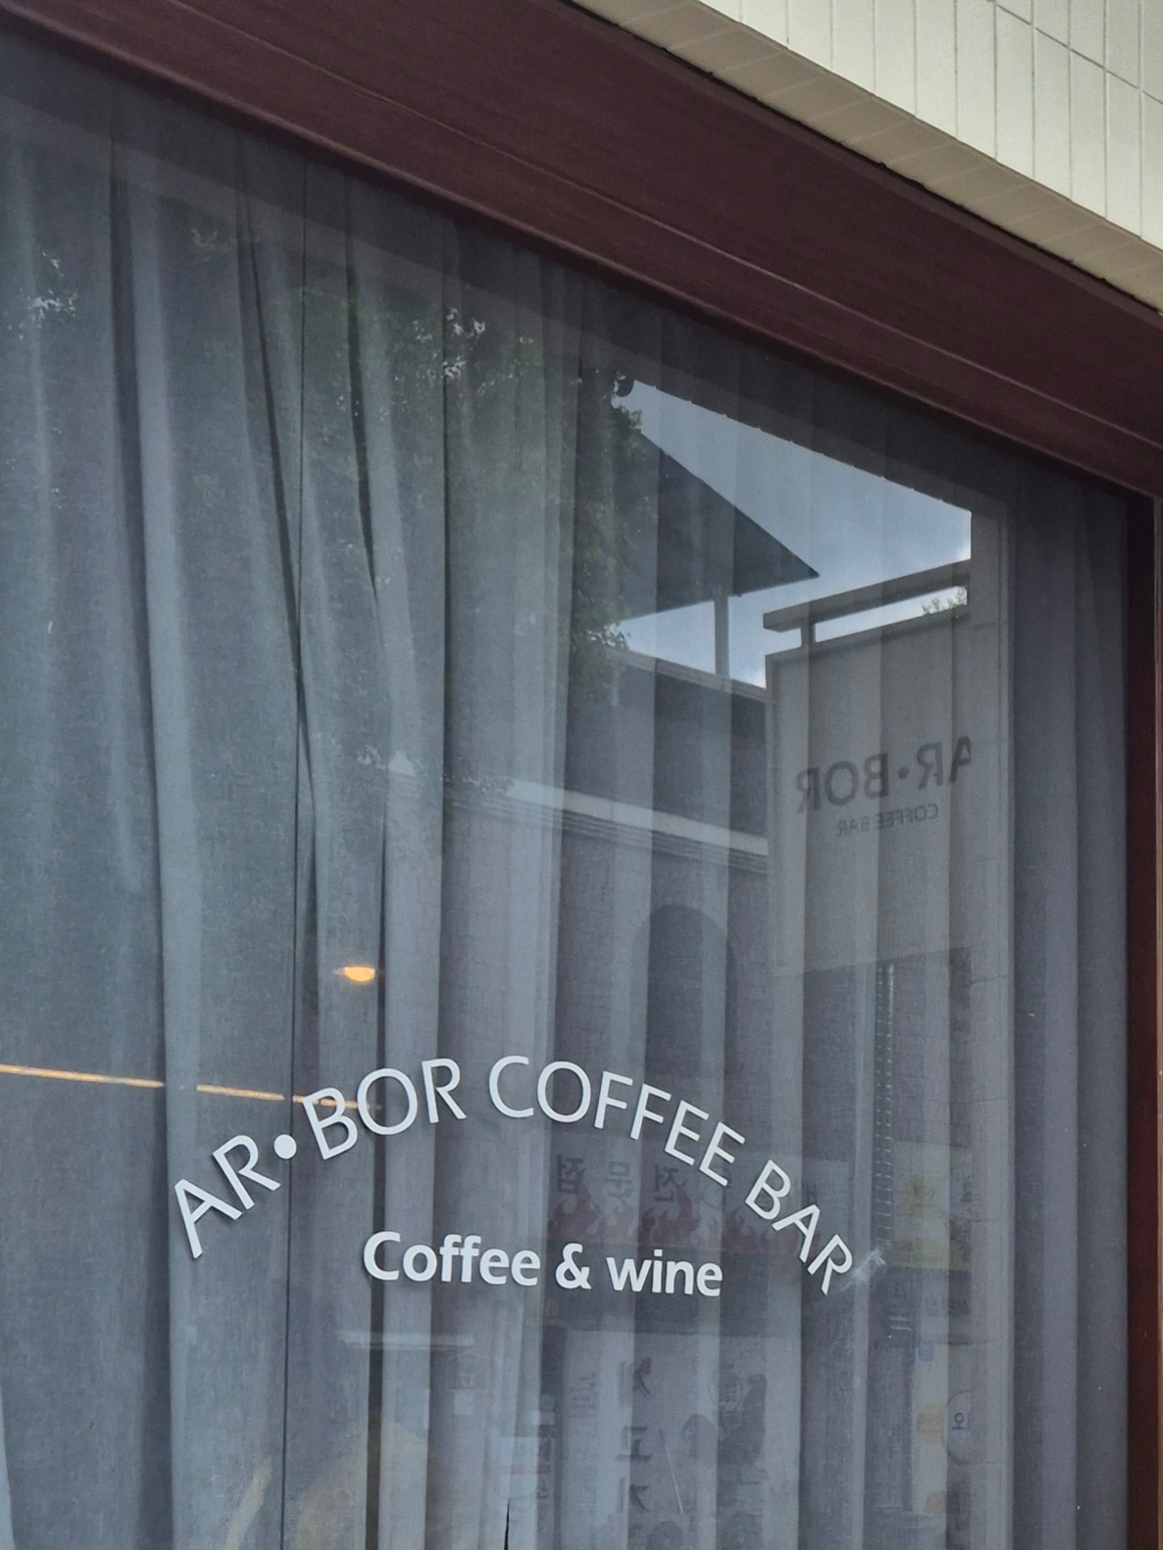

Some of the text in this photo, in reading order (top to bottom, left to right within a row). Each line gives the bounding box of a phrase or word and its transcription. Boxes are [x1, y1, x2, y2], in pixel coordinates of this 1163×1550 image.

[489, 1055, 745, 1186] COFFEE
[745, 1159, 853, 1295] BAR
[364, 1231, 723, 1297] Coffee & wine
